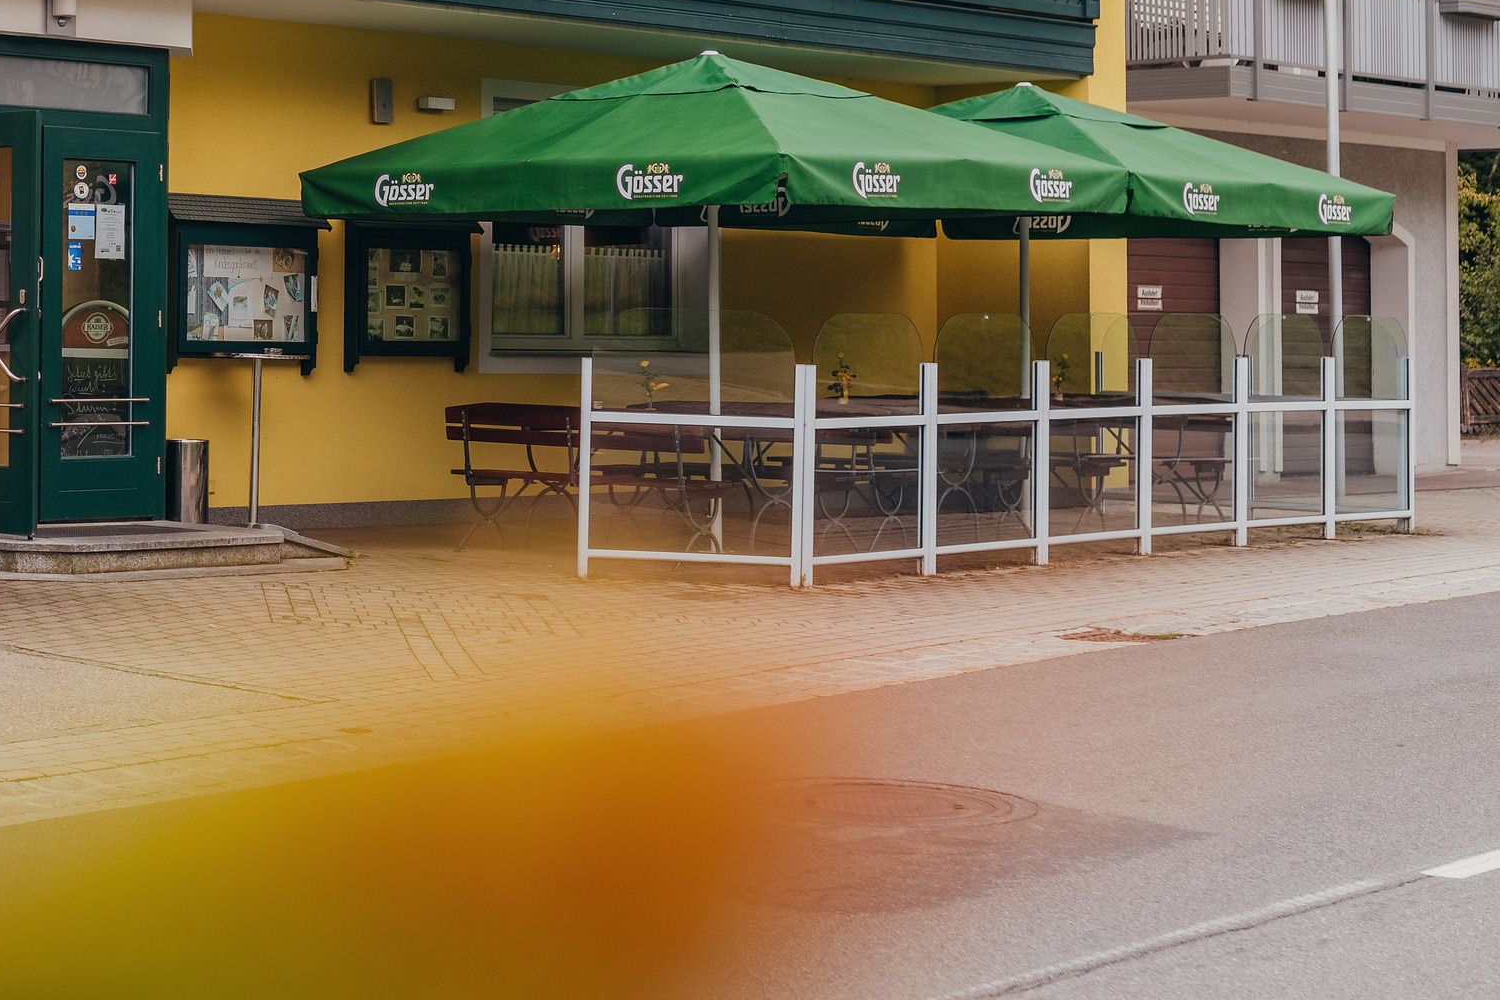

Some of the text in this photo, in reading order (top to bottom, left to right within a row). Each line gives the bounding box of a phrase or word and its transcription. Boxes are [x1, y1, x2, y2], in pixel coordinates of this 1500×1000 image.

[374, 173, 435, 207] Gösser
[616, 163, 684, 201] Gösser
[852, 161, 901, 199] Gösser
[1029, 167, 1073, 203] Gösser
[1183, 182, 1220, 215] Gösser
[1318, 193, 1352, 225] Gösser
[86, 323, 109, 332] KAISER
